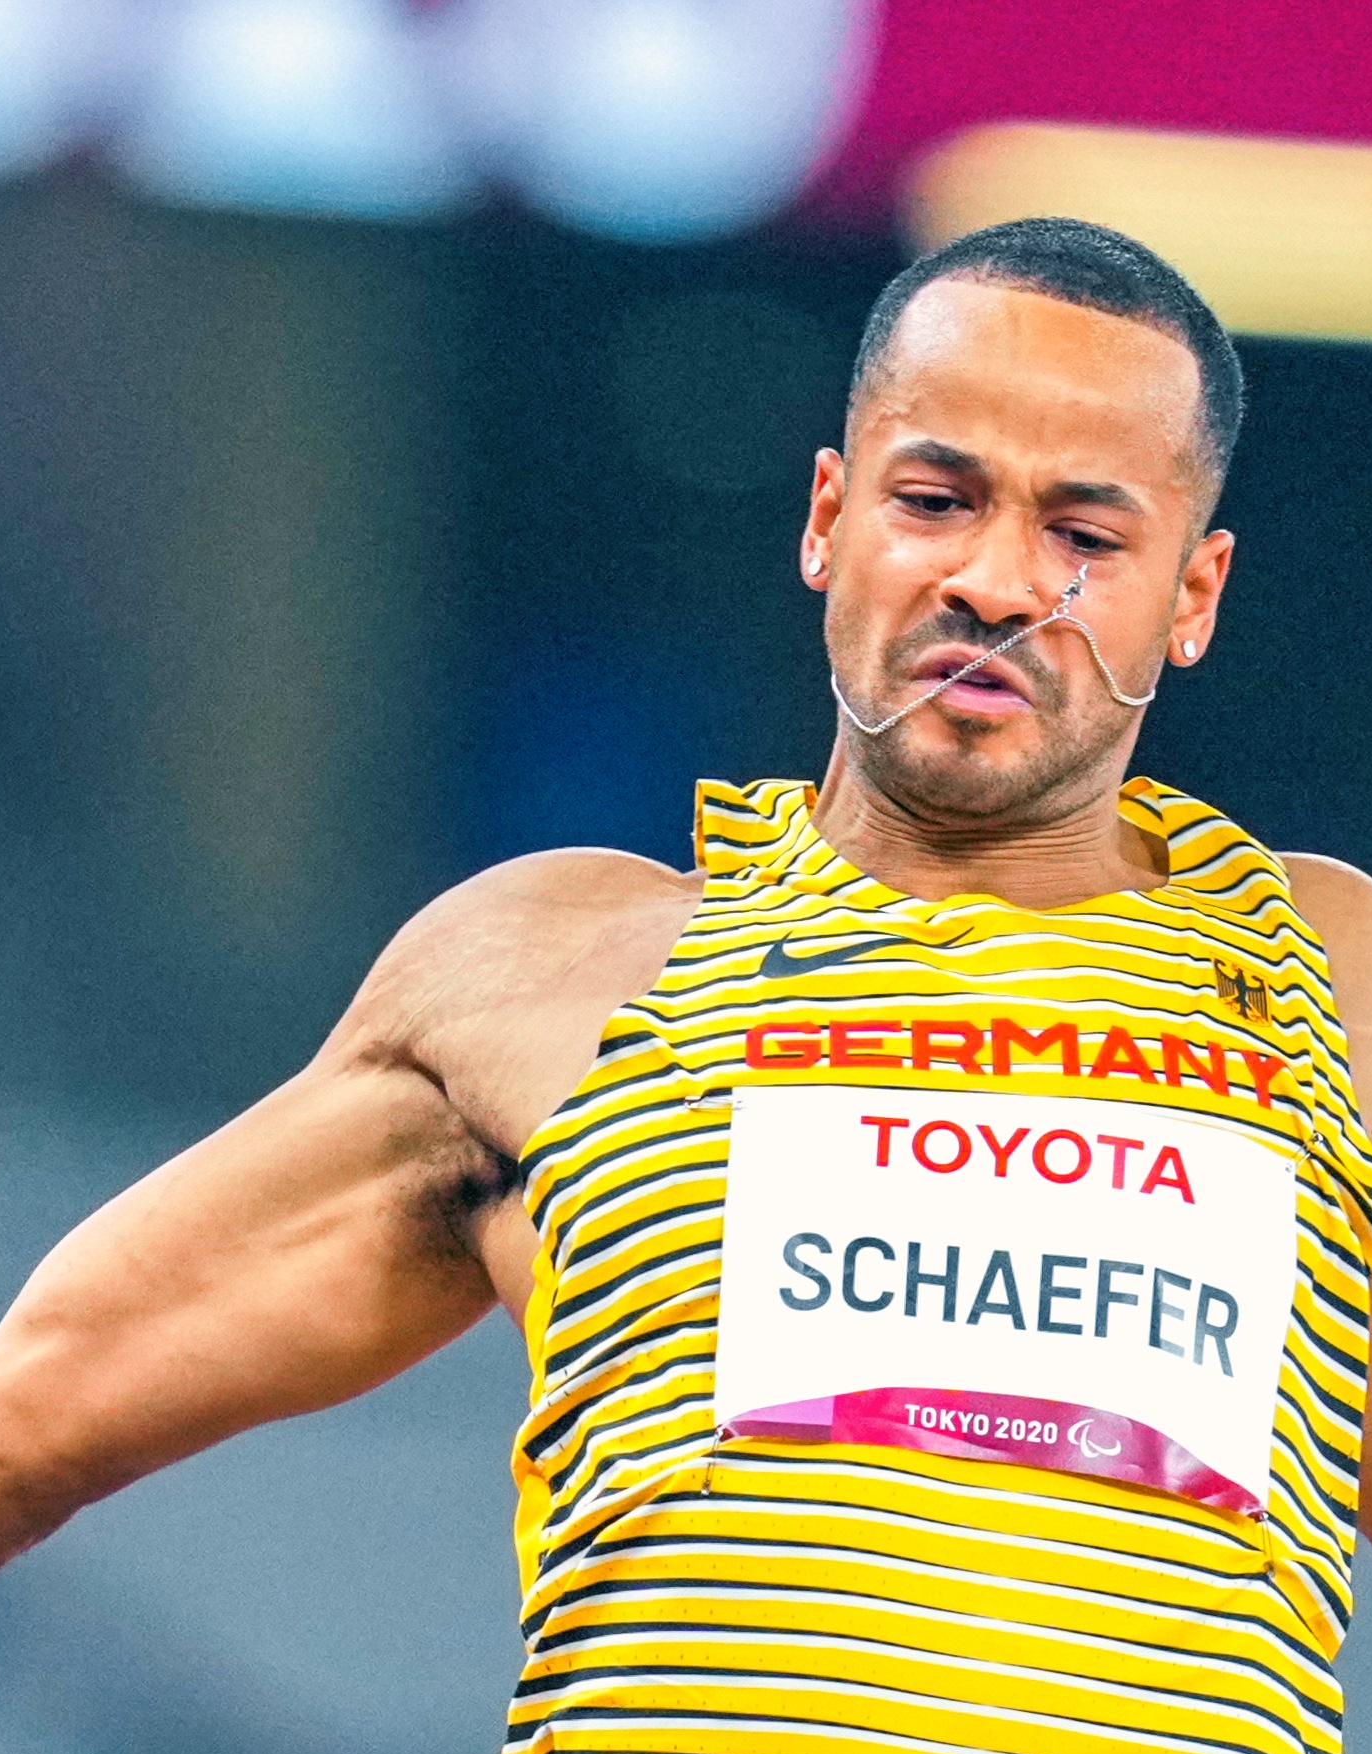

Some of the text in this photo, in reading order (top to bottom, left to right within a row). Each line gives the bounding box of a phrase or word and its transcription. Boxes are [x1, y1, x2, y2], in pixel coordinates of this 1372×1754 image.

[744, 1018, 1289, 1110] GERMANY
[860, 1115, 1196, 1205] TOYOTA
[778, 1231, 1239, 1378] SCHAEFER
[904, 1403, 1059, 1445] TOKYO 2020
